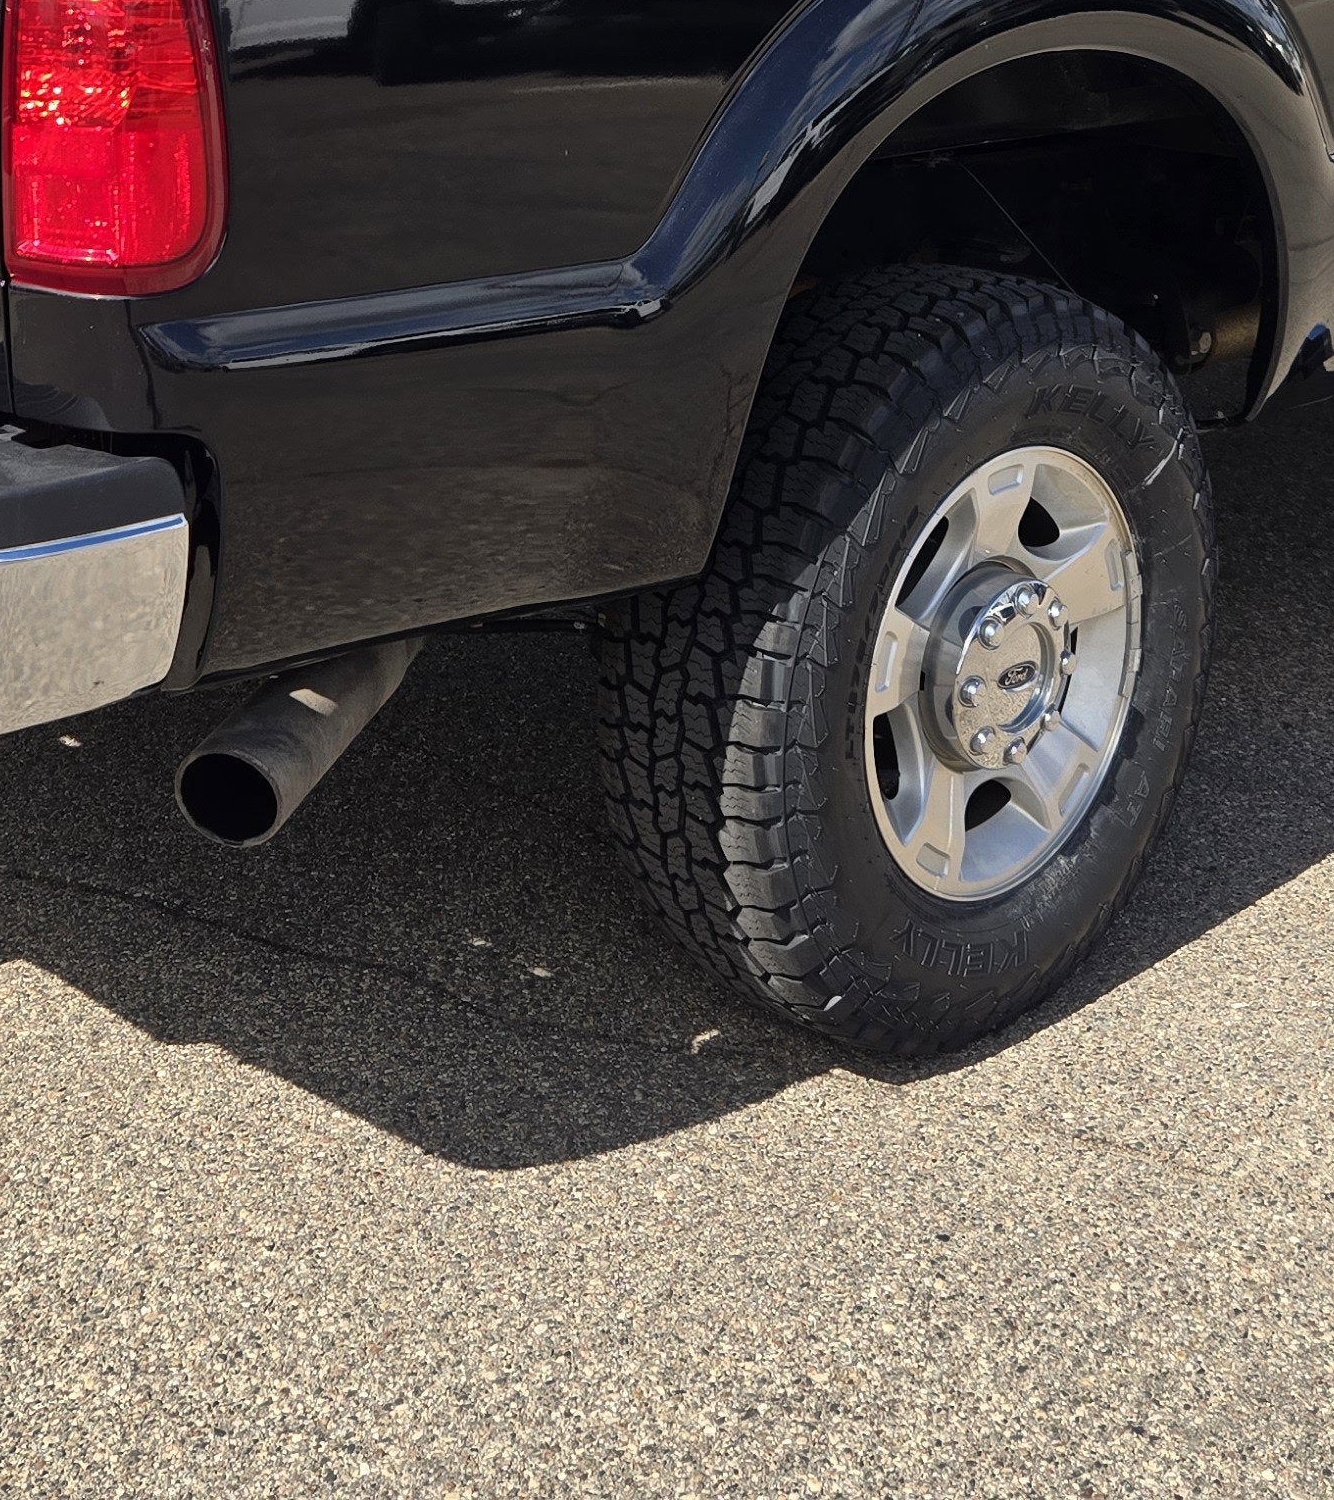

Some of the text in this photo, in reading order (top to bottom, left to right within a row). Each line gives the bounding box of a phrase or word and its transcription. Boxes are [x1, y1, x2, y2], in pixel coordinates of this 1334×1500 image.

[1025, 383, 1155, 449] KELLY
[1004, 667, 1028, 686] Ford
[889, 917, 1029, 977] KELLY
